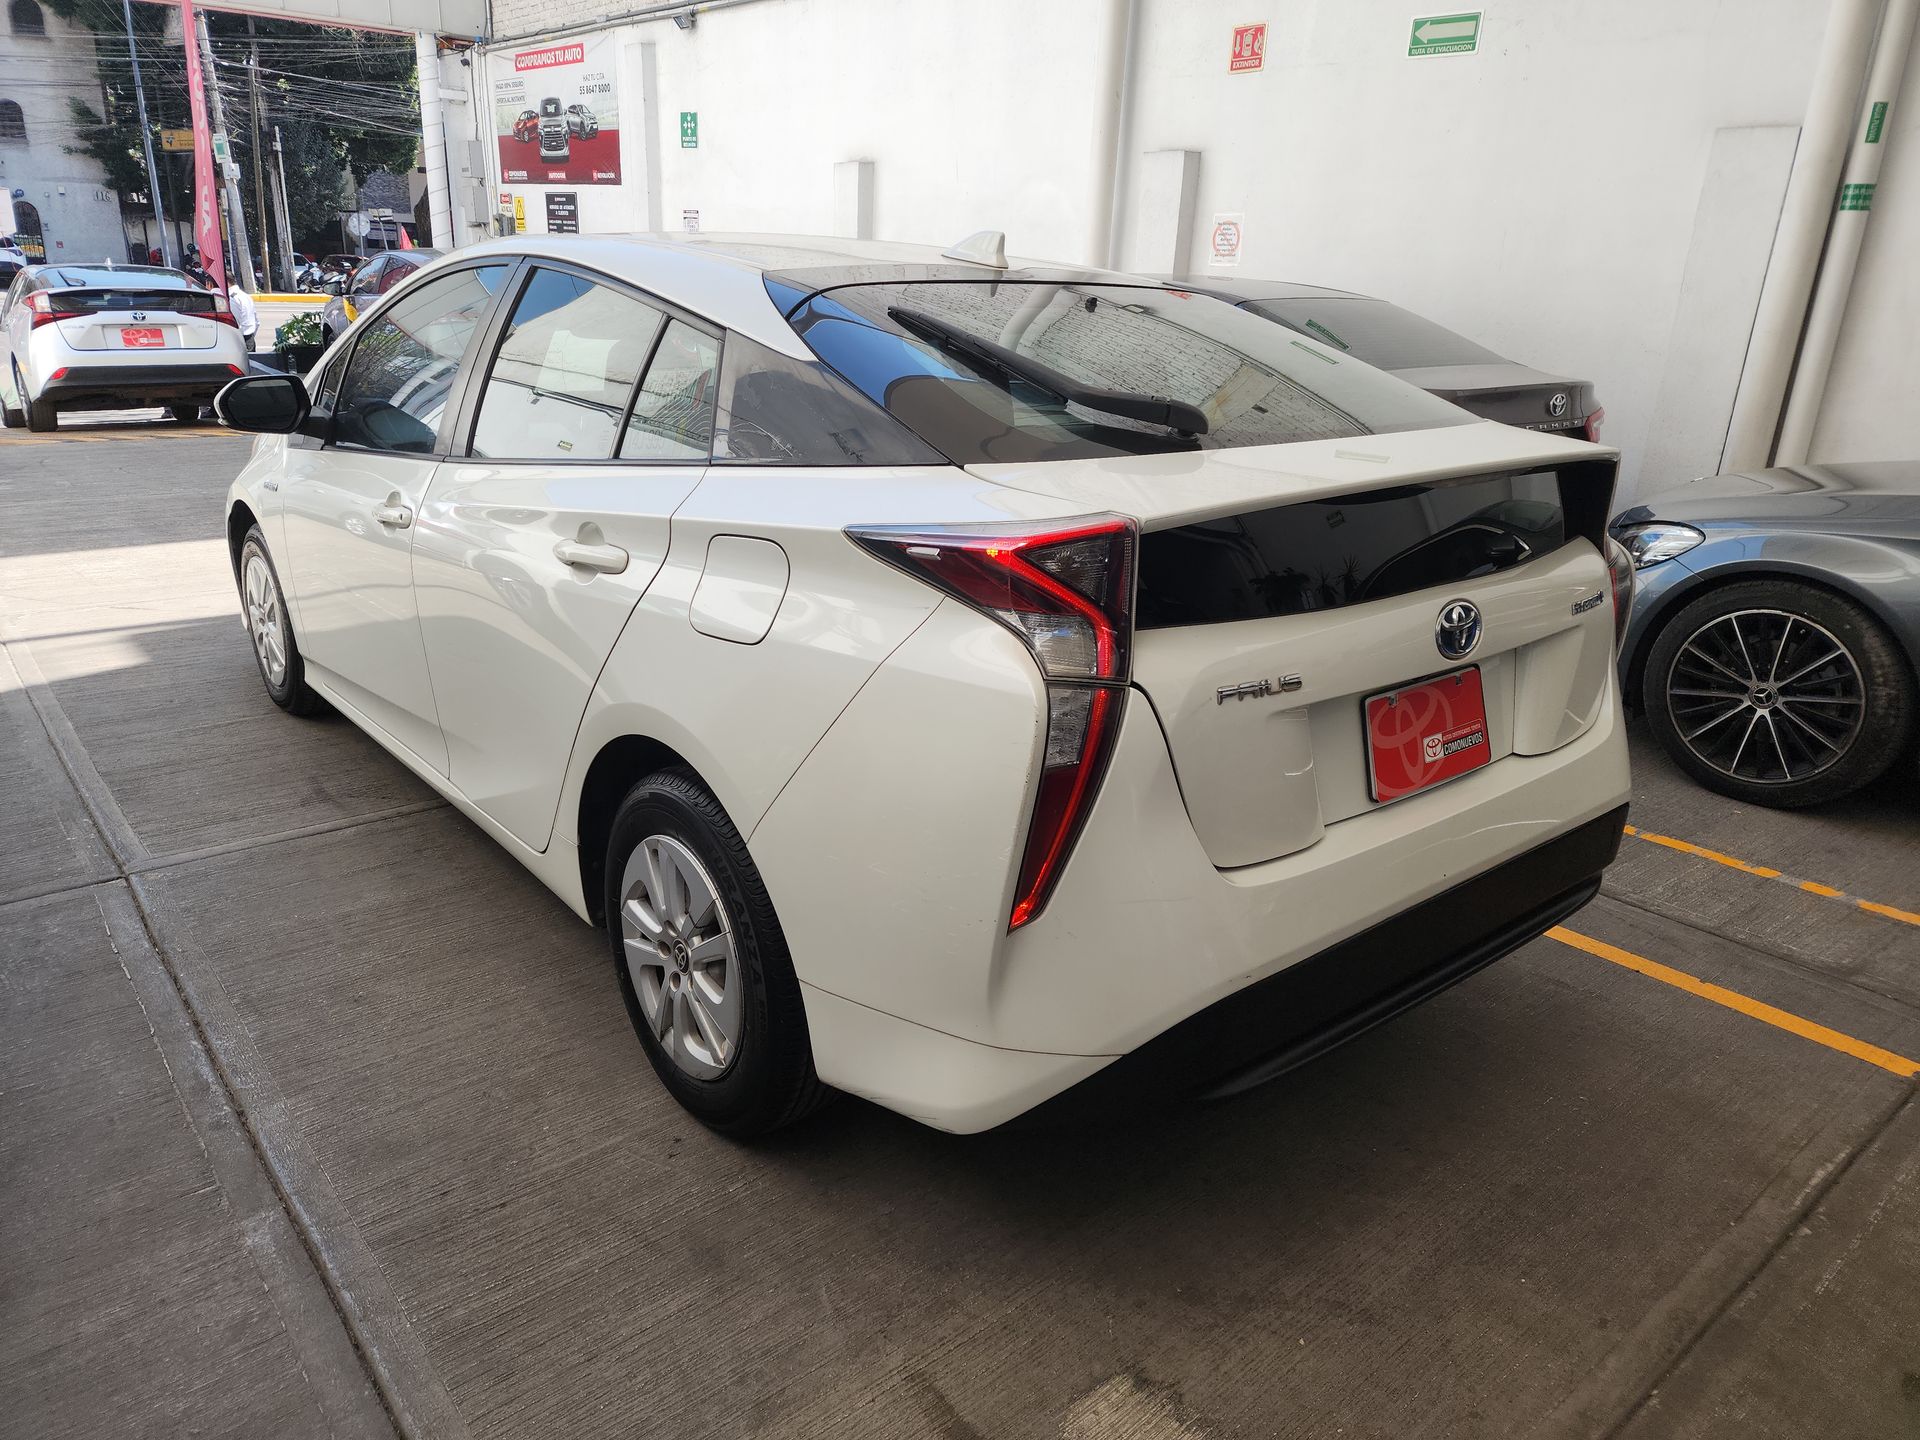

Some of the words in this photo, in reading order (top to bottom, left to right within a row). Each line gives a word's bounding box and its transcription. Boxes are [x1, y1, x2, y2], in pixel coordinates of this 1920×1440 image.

[516, 51, 556, 68] COMPRAMOS
[556, 49, 565, 63] TU
[565, 47, 582, 61] AUTO
[1232, 58, 1260, 69] EXTINTOR
[1216, 673, 1303, 706] PRIUS
[1444, 731, 1483, 755] COMONUEVOS
